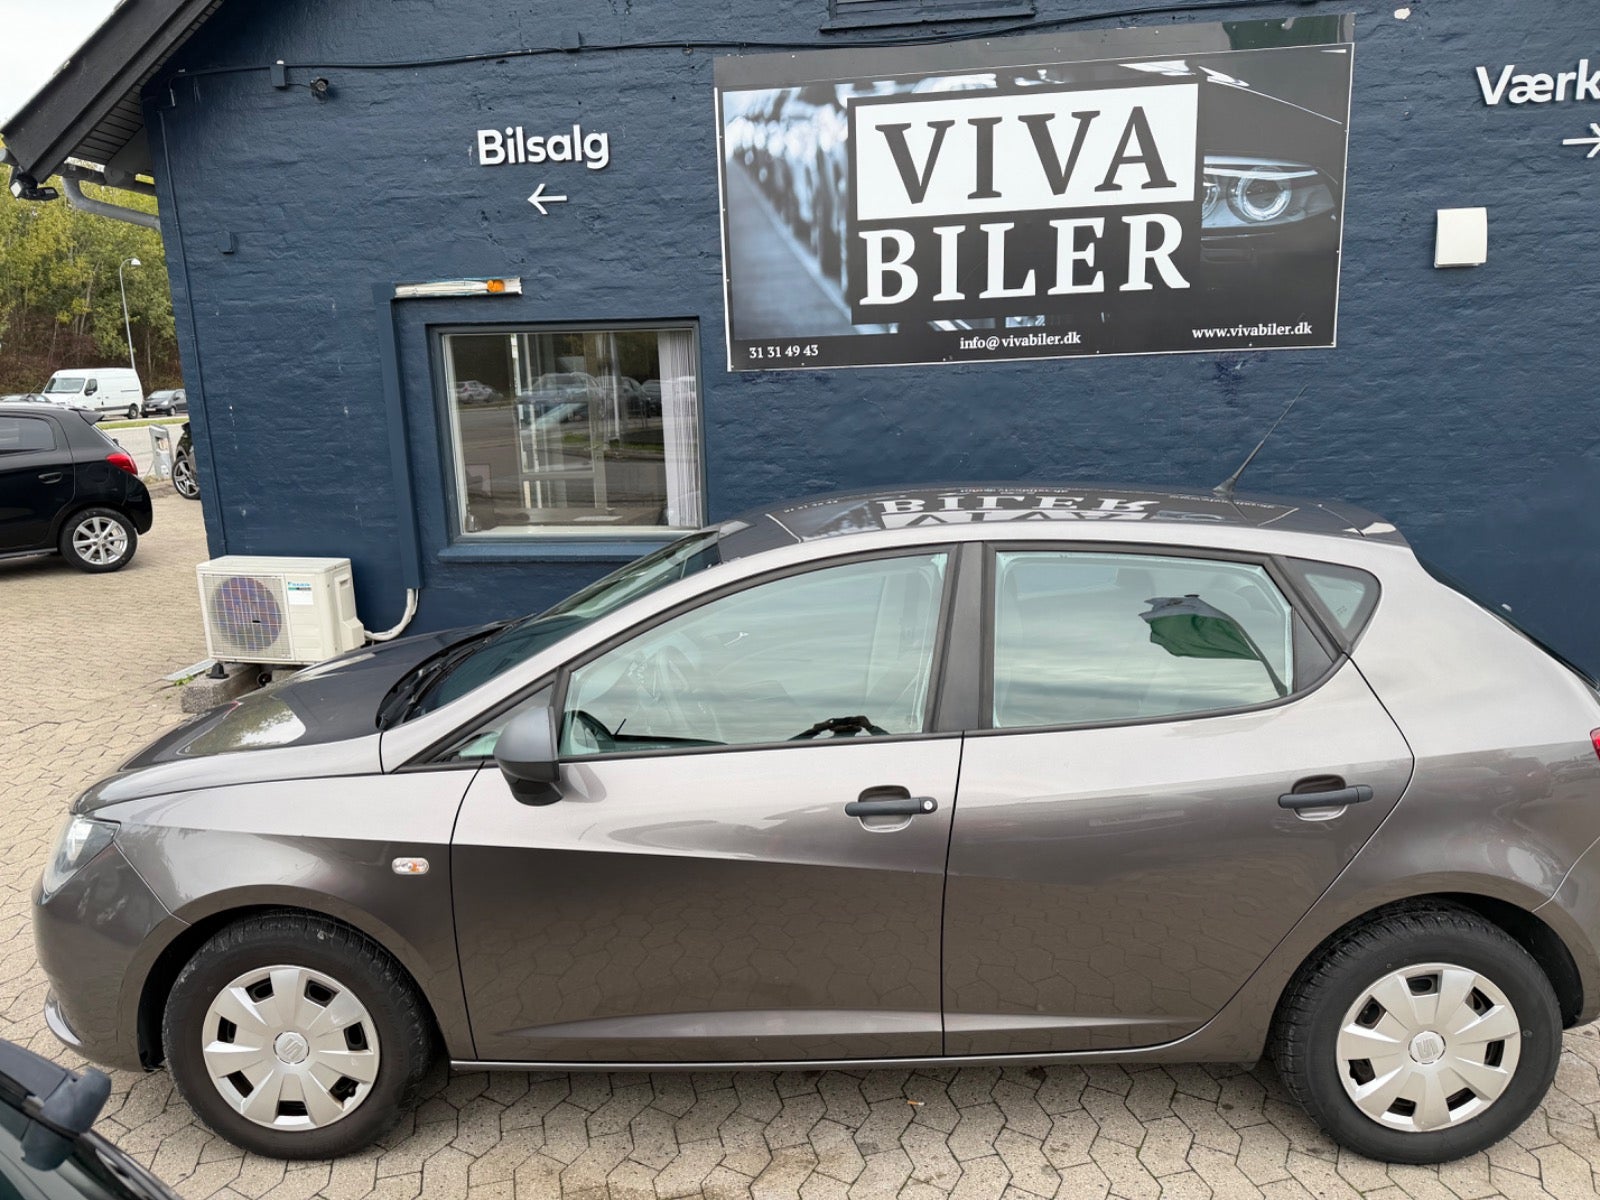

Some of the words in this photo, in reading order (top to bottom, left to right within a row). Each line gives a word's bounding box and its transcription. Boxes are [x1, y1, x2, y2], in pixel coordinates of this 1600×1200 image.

[477, 124, 609, 169] Bilsalg
[875, 106, 1177, 204] VIVA
[858, 213, 1191, 305] BILER
[749, 347, 763, 358] 31
[767, 346, 781, 357] 31
[785, 345, 800, 357] 49
[803, 344, 818, 356] 43
[1192, 321, 1313, 339] www.vivabiler.dk
